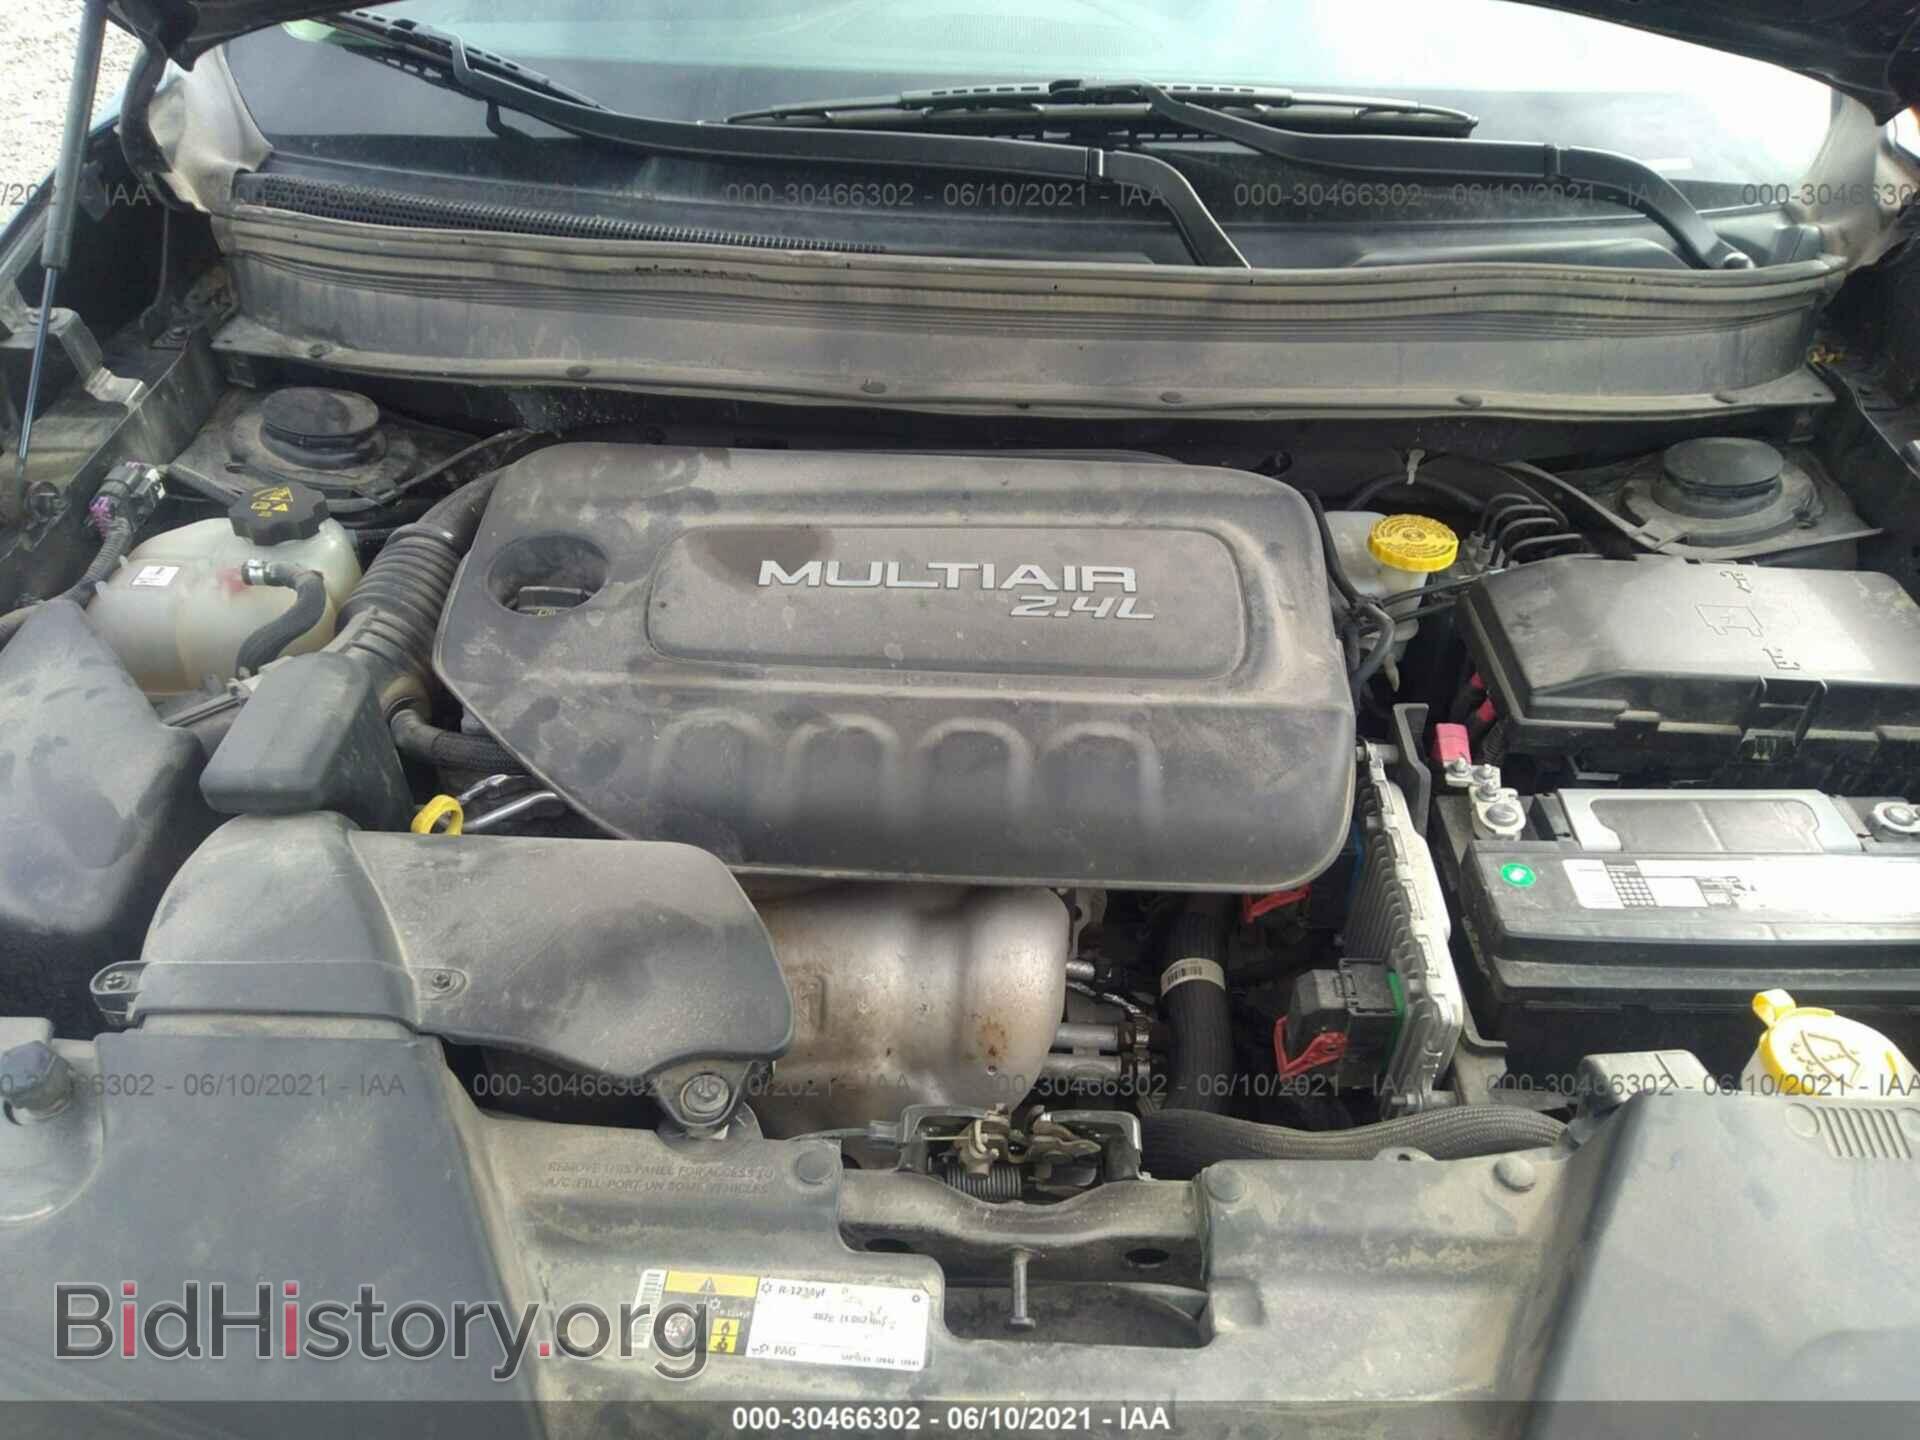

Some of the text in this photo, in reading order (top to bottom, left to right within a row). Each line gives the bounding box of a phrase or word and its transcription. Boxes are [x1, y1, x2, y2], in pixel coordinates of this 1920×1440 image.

[757, 559, 1138, 593] MULTIAIR
[1010, 595, 1155, 621] 2.4L
[773, 1345, 797, 1359] PAG
